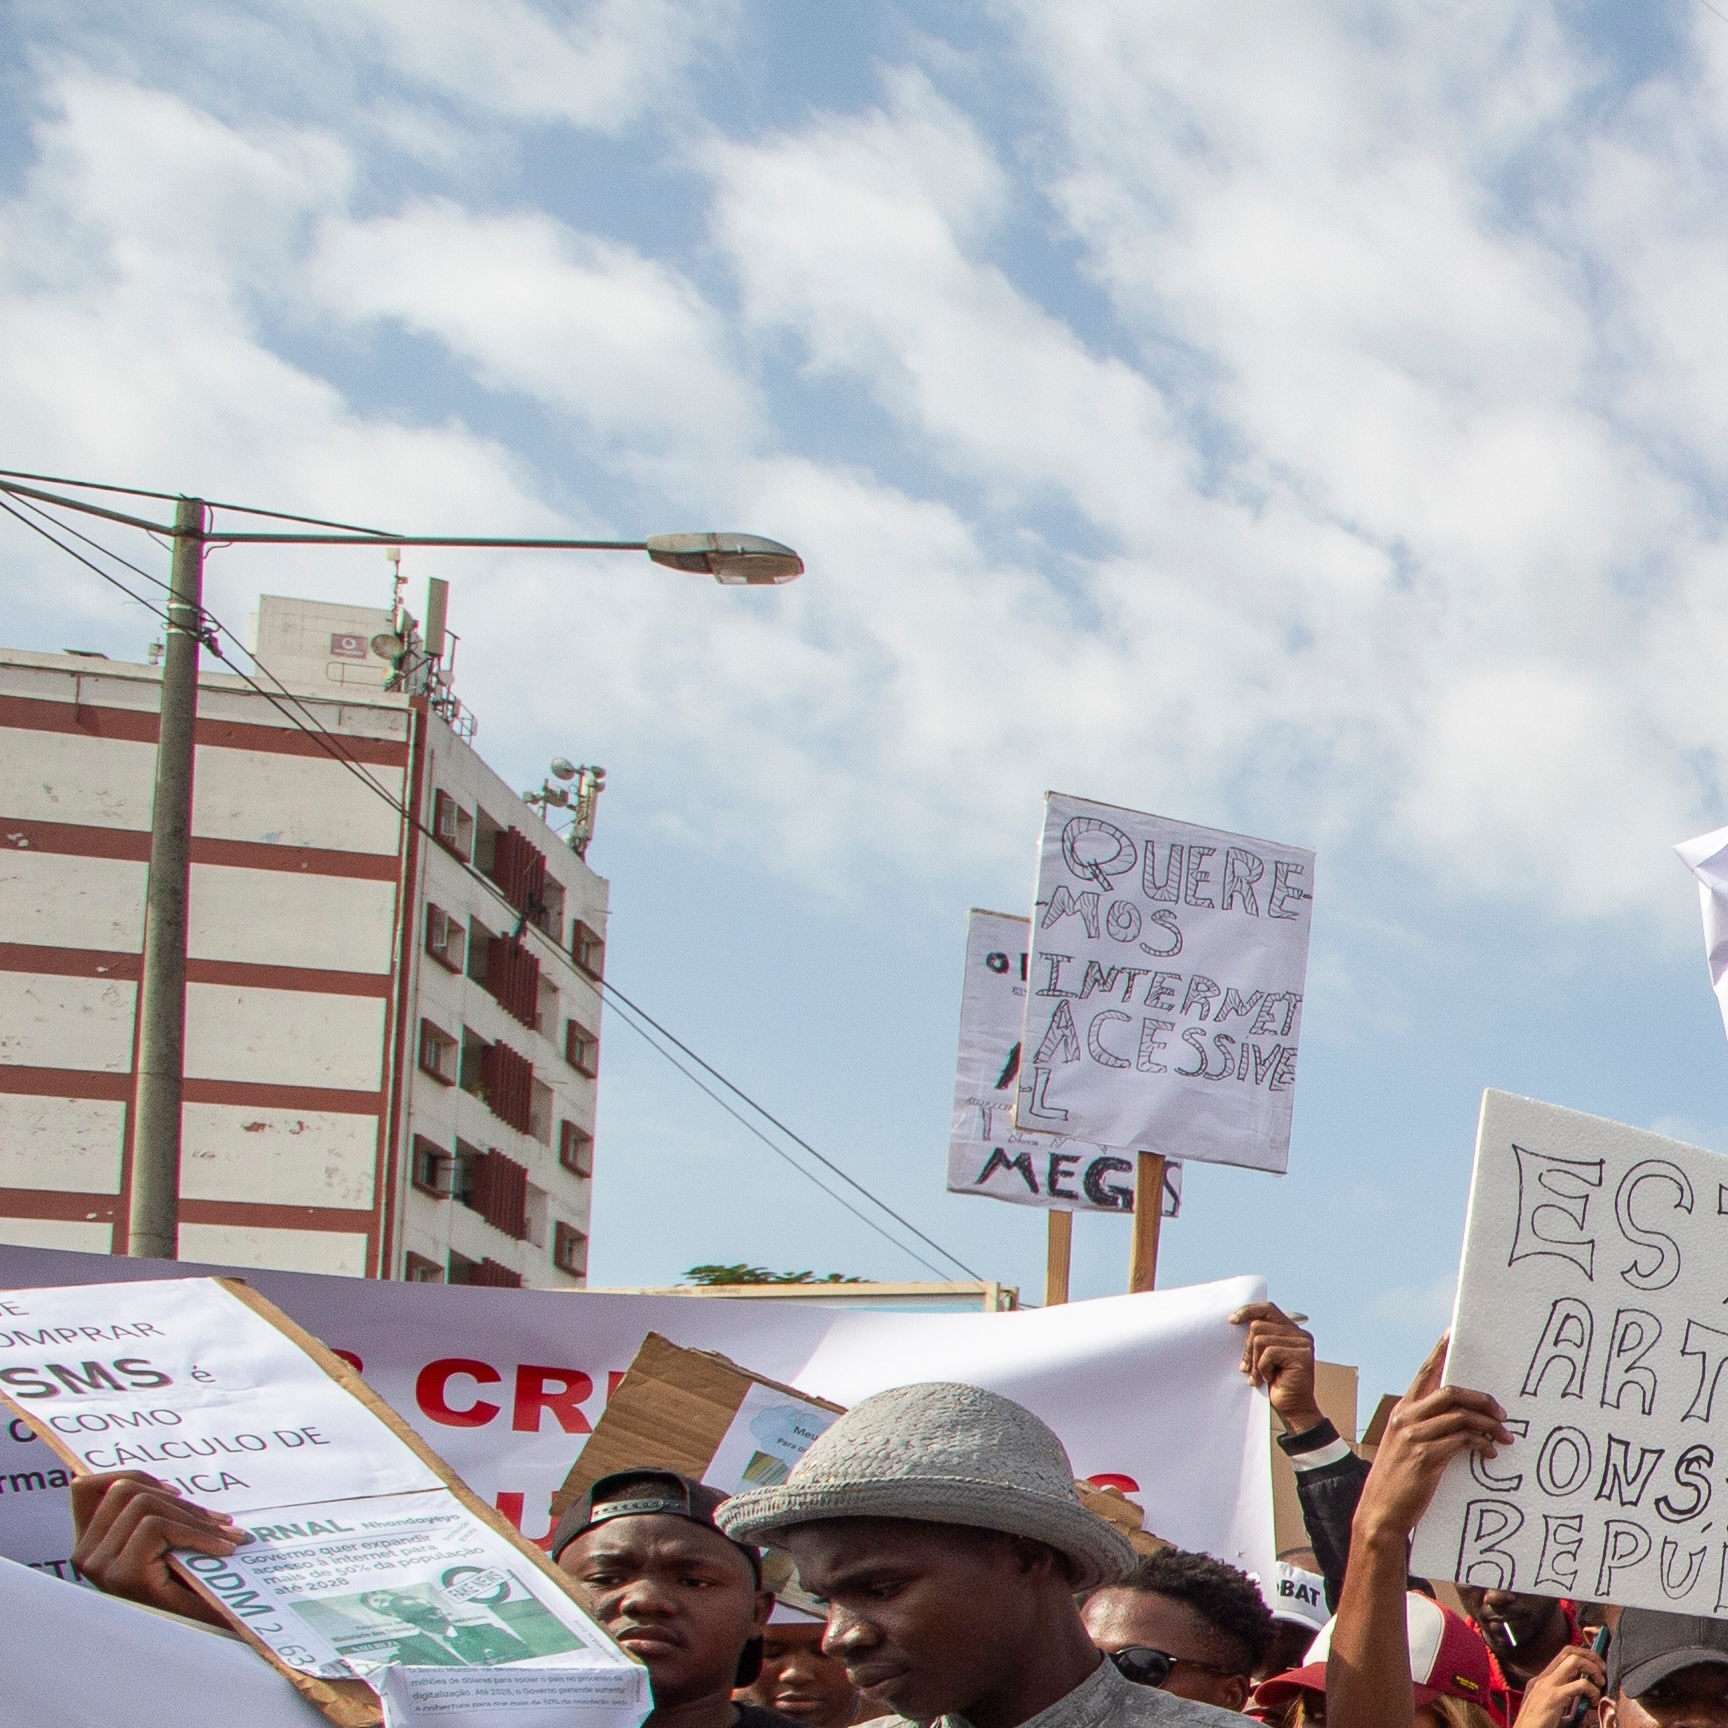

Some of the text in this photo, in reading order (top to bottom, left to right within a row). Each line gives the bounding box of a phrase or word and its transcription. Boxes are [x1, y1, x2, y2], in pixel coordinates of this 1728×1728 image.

[0, 1301, 29, 1316] E
[0, 1358, 216, 1399] SMS é
[50, 1409, 183, 1434] COMO
[84, 1426, 331, 1468] CÁLCULO DE
[160, 1472, 250, 1496] ICA
[249, 1519, 355, 1545] RNAL
[241, 1532, 432, 1566] Governo quer expandir
[253, 1560, 315, 1575] acesso
[331, 1549, 400, 1567] internet
[403, 1543, 438, 1558] para
[263, 1546, 485, 1586] mais de 50% da população
[273, 1576, 350, 1597] até 2028
[447, 1570, 506, 1600] FAKE NEWS
[1276, 1580, 1321, 1608] BAT
